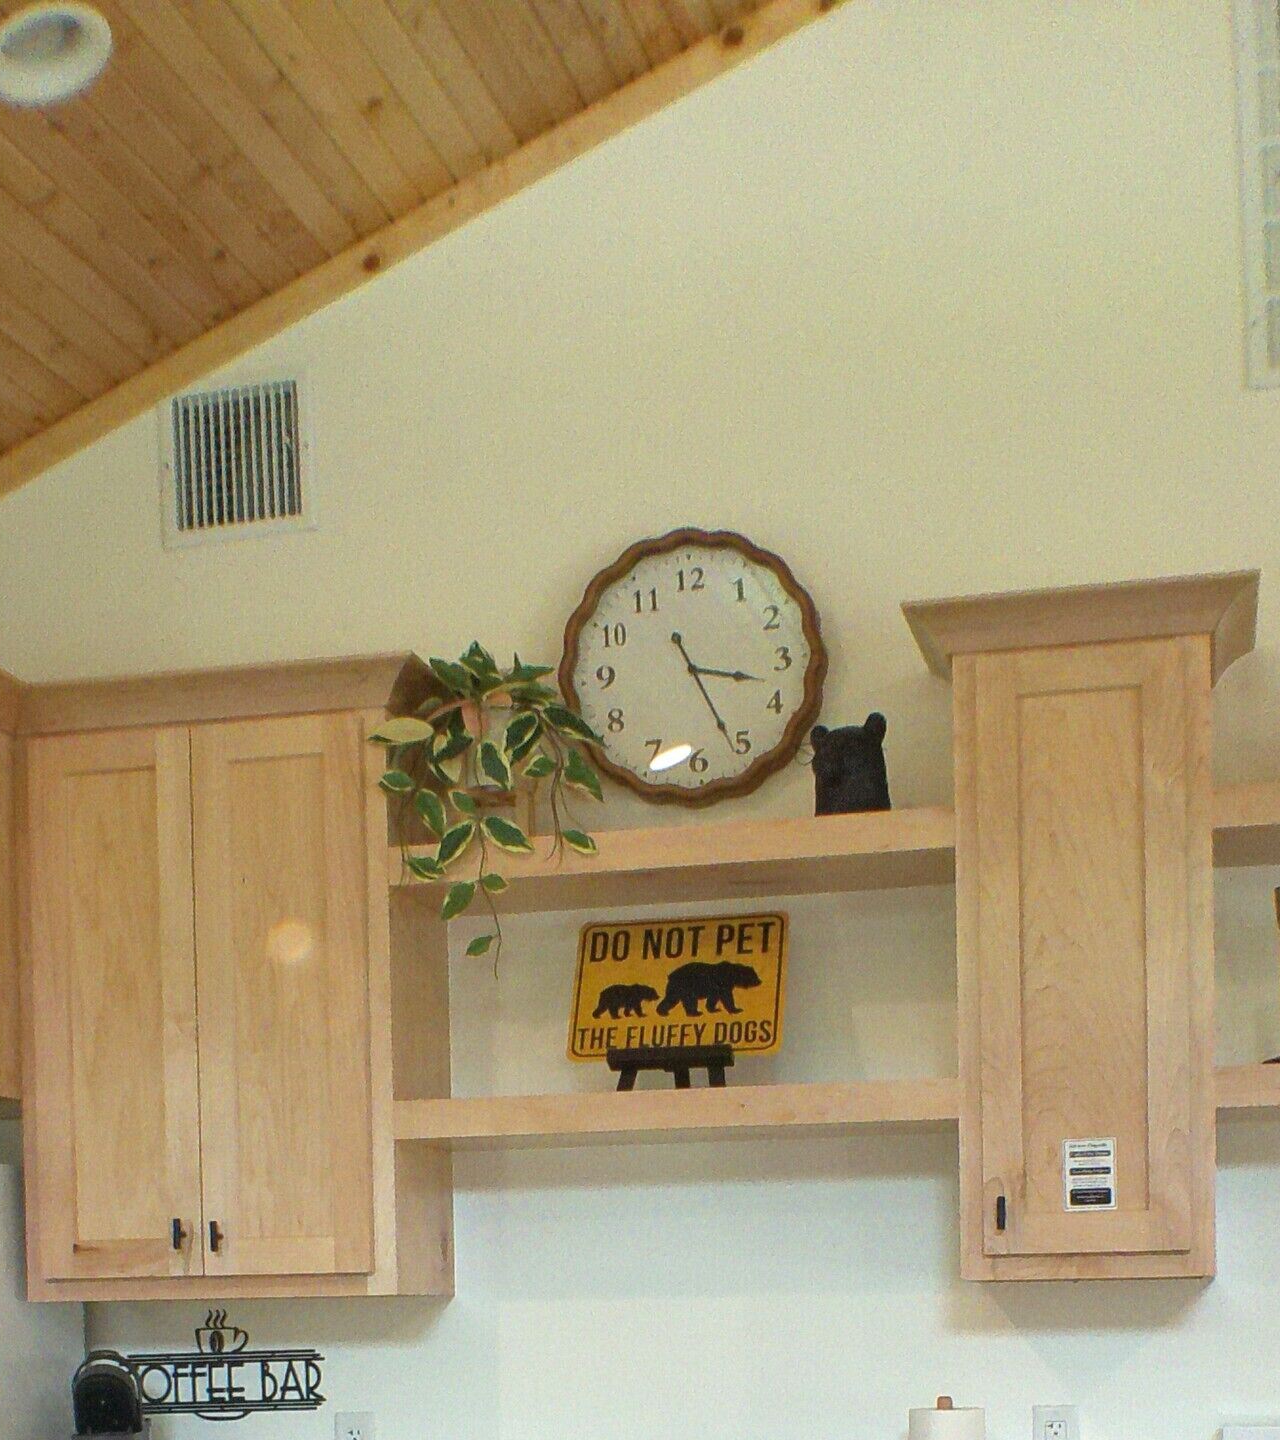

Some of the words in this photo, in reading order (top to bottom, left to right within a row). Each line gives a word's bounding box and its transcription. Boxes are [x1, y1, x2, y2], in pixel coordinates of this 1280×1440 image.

[676, 567, 705, 592] 12
[732, 578, 747, 602] 1
[633, 588, 659, 613] 11
[763, 604, 780, 630] 2
[601, 622, 627, 648] 10
[773, 647, 793, 671] 3
[596, 665, 615, 689] 9
[766, 689, 784, 715] 4
[607, 708, 625, 733] 8
[645, 738, 663, 761] 7
[735, 730, 751, 755] 5
[689, 748, 709, 773] 6
[589, 930, 631, 963] DO
[642, 925, 706, 960] NOT
[716, 921, 776, 956] PET
[578, 1026, 618, 1050] THE
[626, 1022, 707, 1048] FLUFFY
[714, 1020, 773, 1044] DOGS
[137, 1360, 246, 1403] OFFEE
[261, 1359, 326, 1401] BAR
